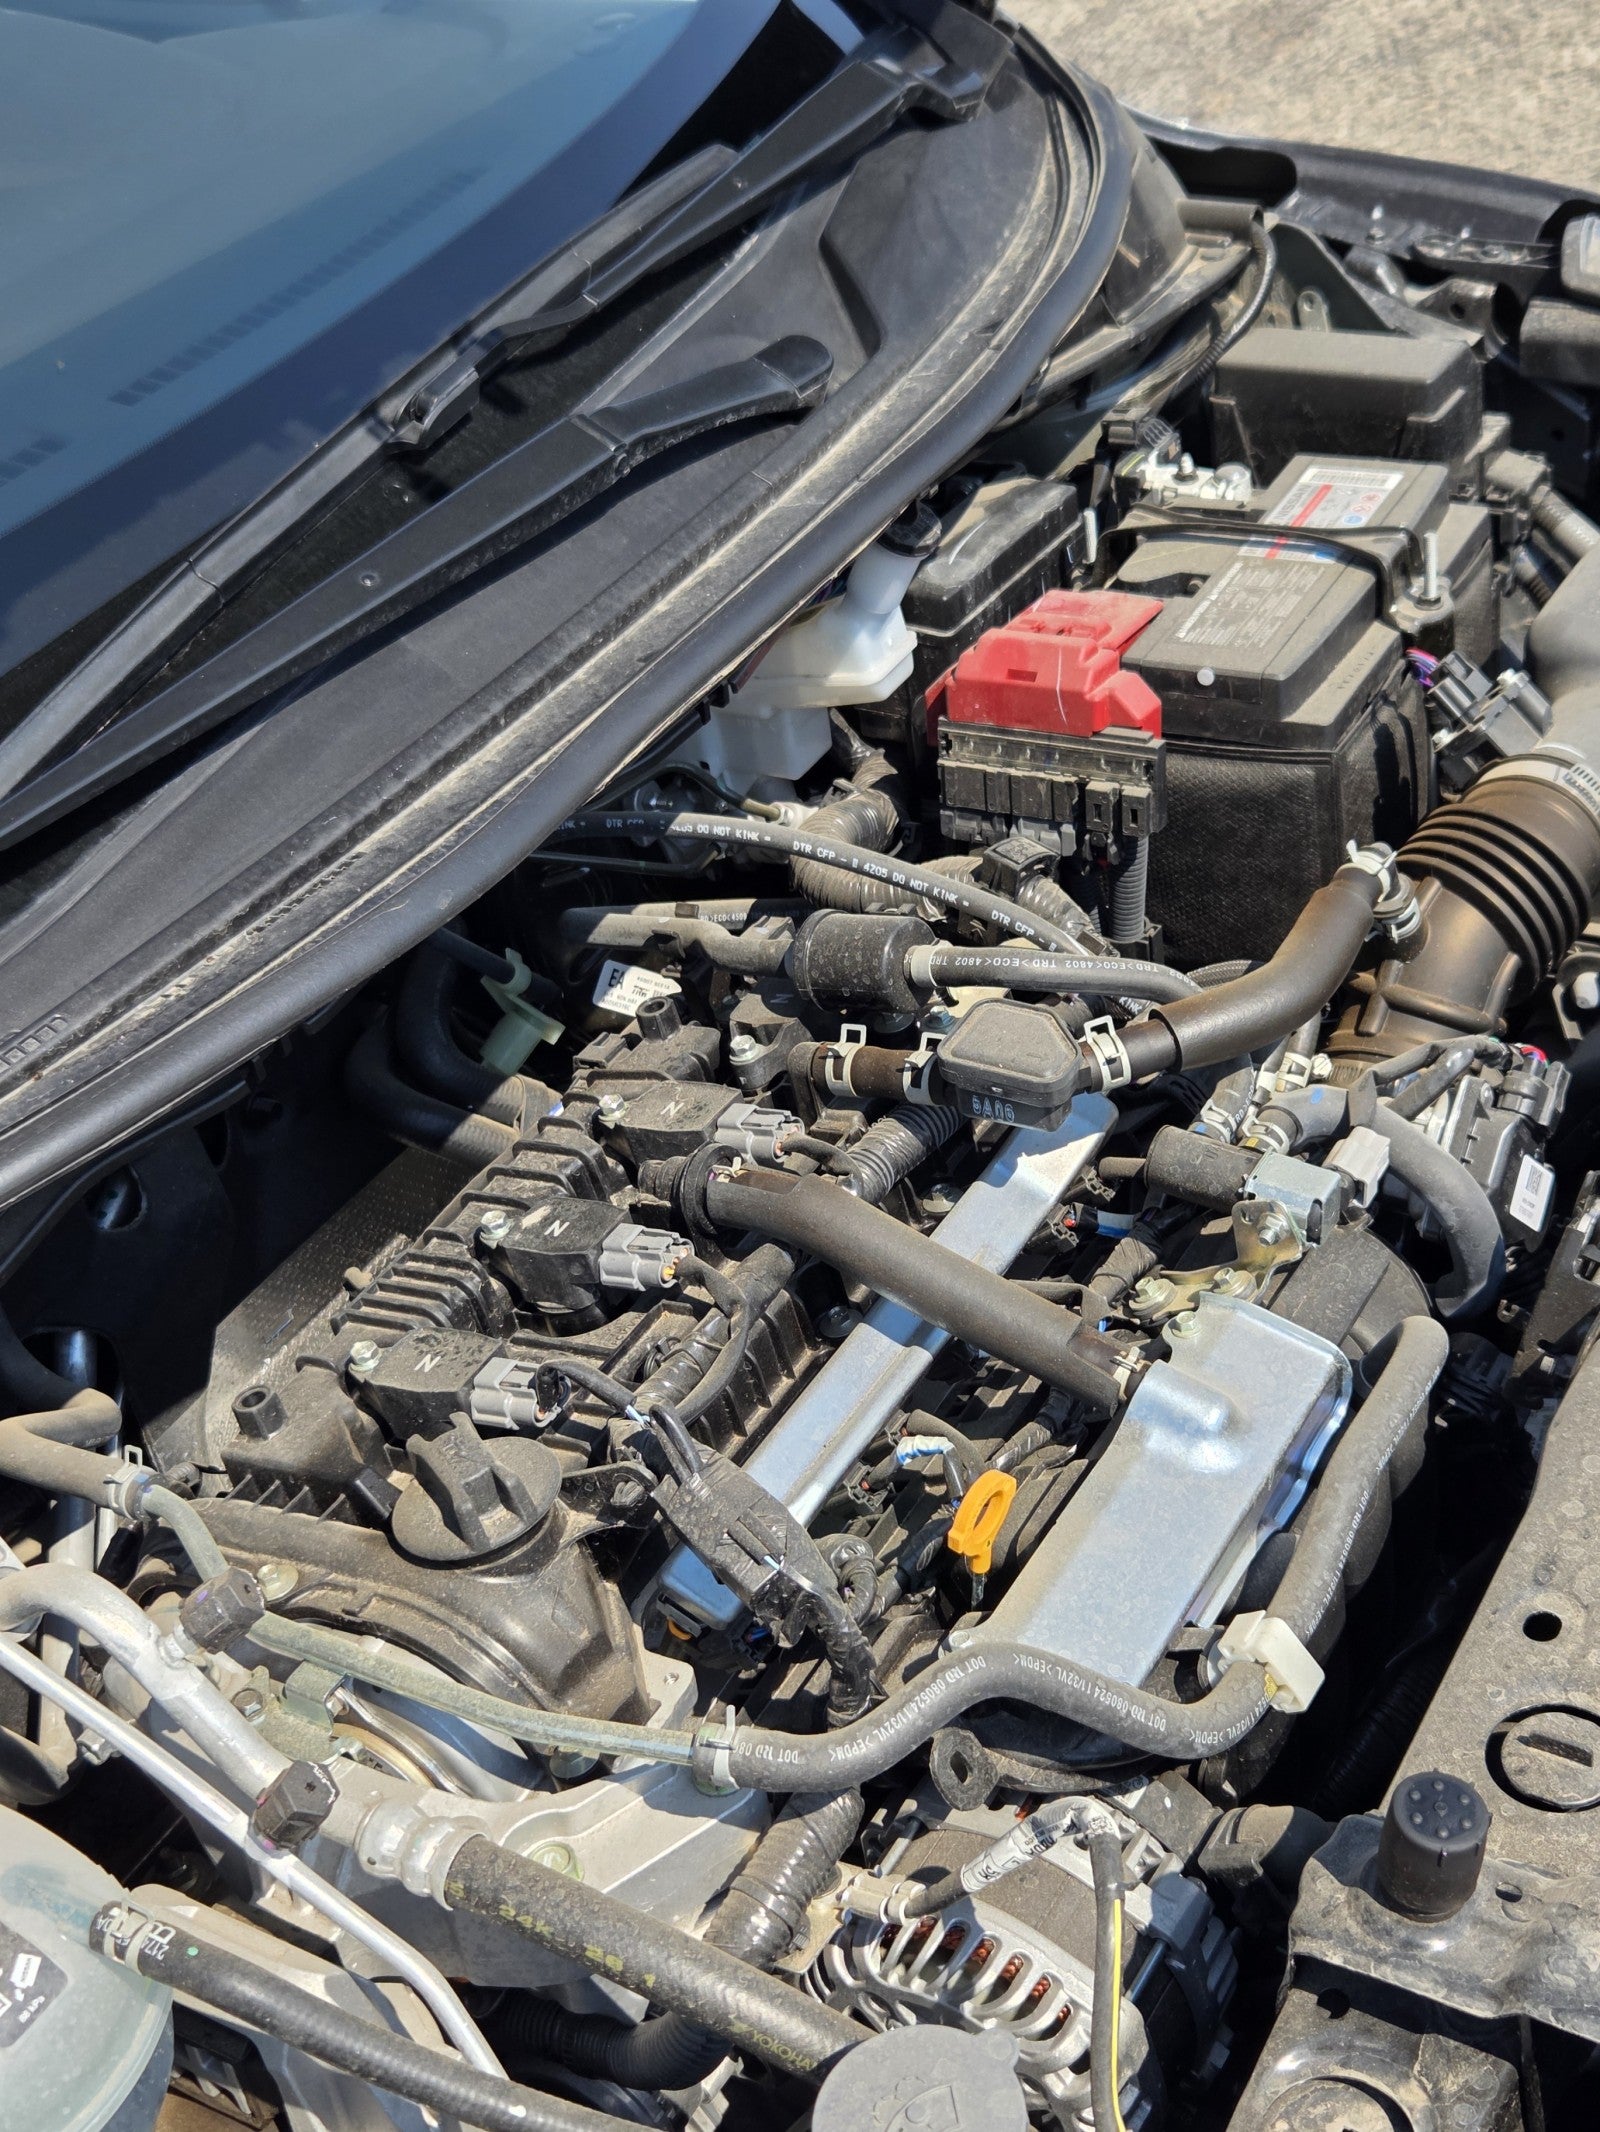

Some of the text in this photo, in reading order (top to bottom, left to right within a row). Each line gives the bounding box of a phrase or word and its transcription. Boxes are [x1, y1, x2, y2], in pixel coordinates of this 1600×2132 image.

[735, 829, 760, 842] KINK
[793, 840, 813, 856] DTR
[817, 847, 836, 861] CFP
[863, 863, 889, 879] 4205
[892, 871, 906, 885] DO
[909, 877, 929, 893] NOT
[933, 886, 959, 905] KINK
[991, 909, 1011, 926] DTR
[1015, 921, 1035, 938] CFP
[1119, 996, 1143, 1015] KINK
[661, 1101, 685, 1116] N
[544, 1219, 571, 1238] N
[414, 1353, 442, 1374] N
[964, 1655, 987, 1675] DOT
[1147, 1716, 1167, 1732] DOT
[777, 1748, 799, 1764] DOT
